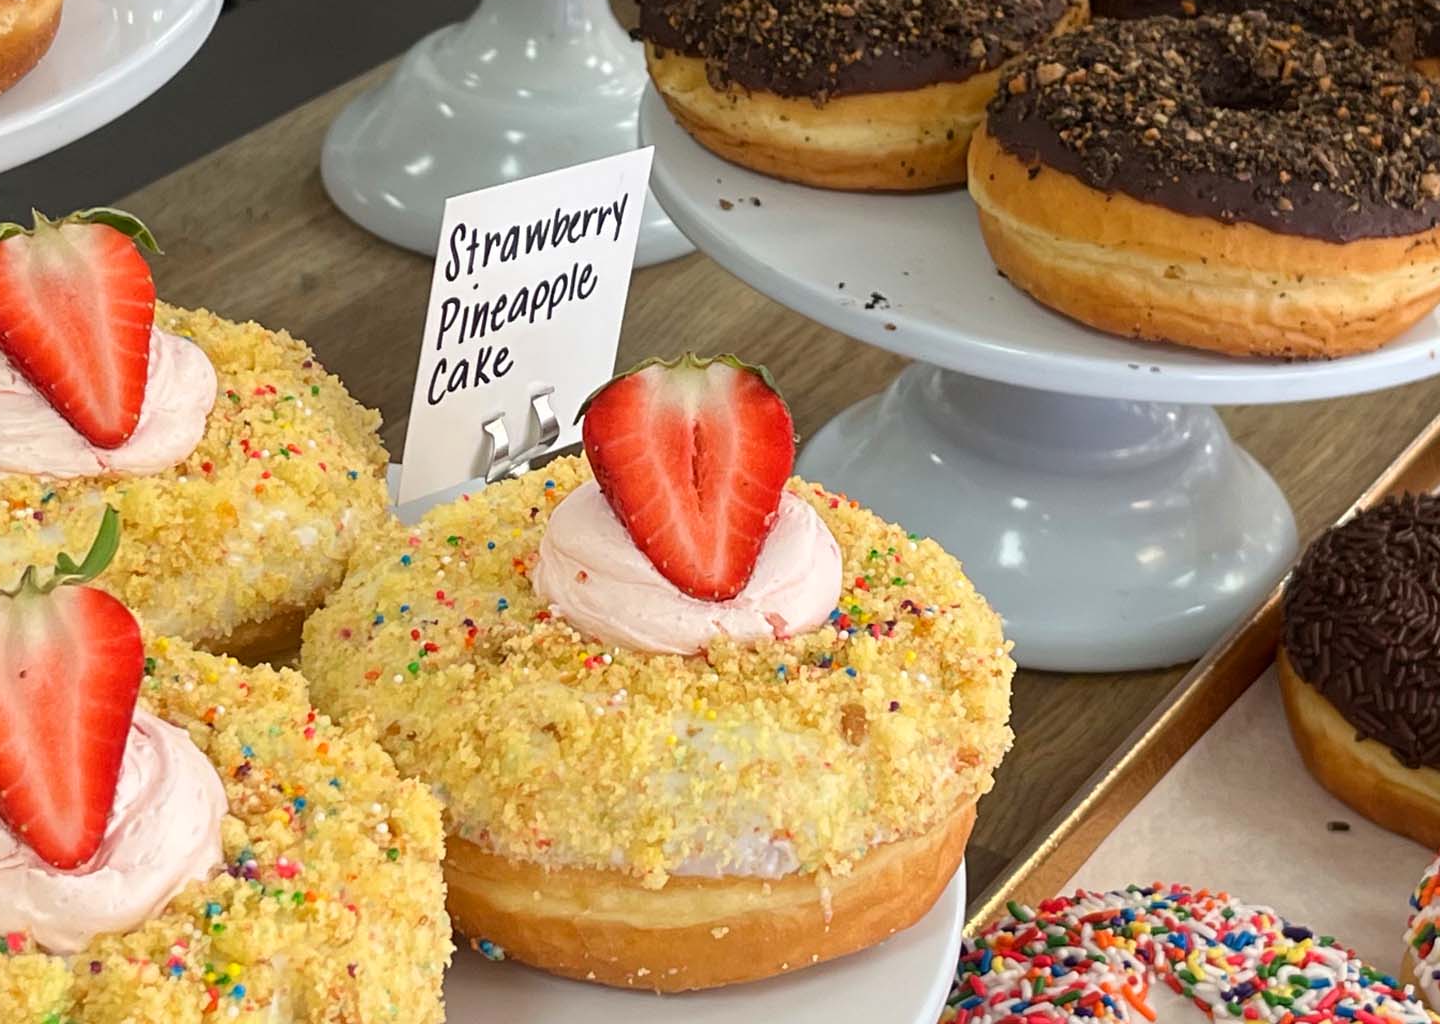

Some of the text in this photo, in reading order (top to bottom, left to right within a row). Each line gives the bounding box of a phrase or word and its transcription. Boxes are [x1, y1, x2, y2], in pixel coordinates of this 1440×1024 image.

[445, 193, 628, 282] Strawberry
[436, 262, 598, 351] Pineapple
[427, 345, 513, 406] Cake
